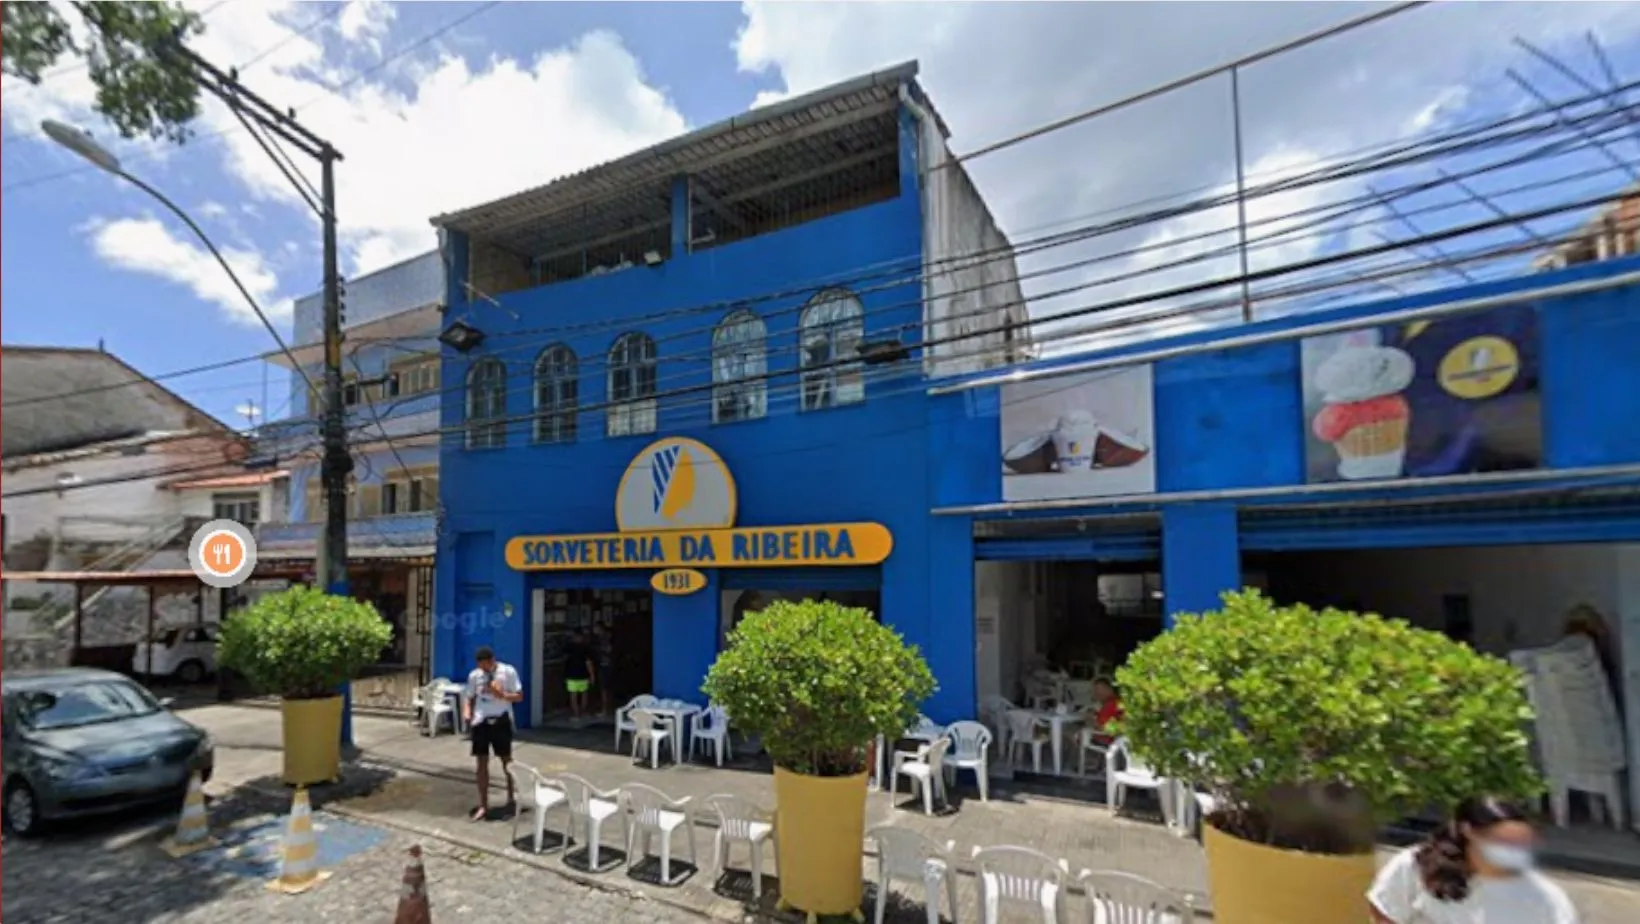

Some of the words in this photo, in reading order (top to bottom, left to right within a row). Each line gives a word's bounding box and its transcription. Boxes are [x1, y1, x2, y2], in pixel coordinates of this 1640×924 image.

[523, 537, 665, 564] SORVETERIA
[680, 534, 716, 561] DA
[732, 529, 855, 560] RIBEIRA
[664, 572, 689, 589] 1931
